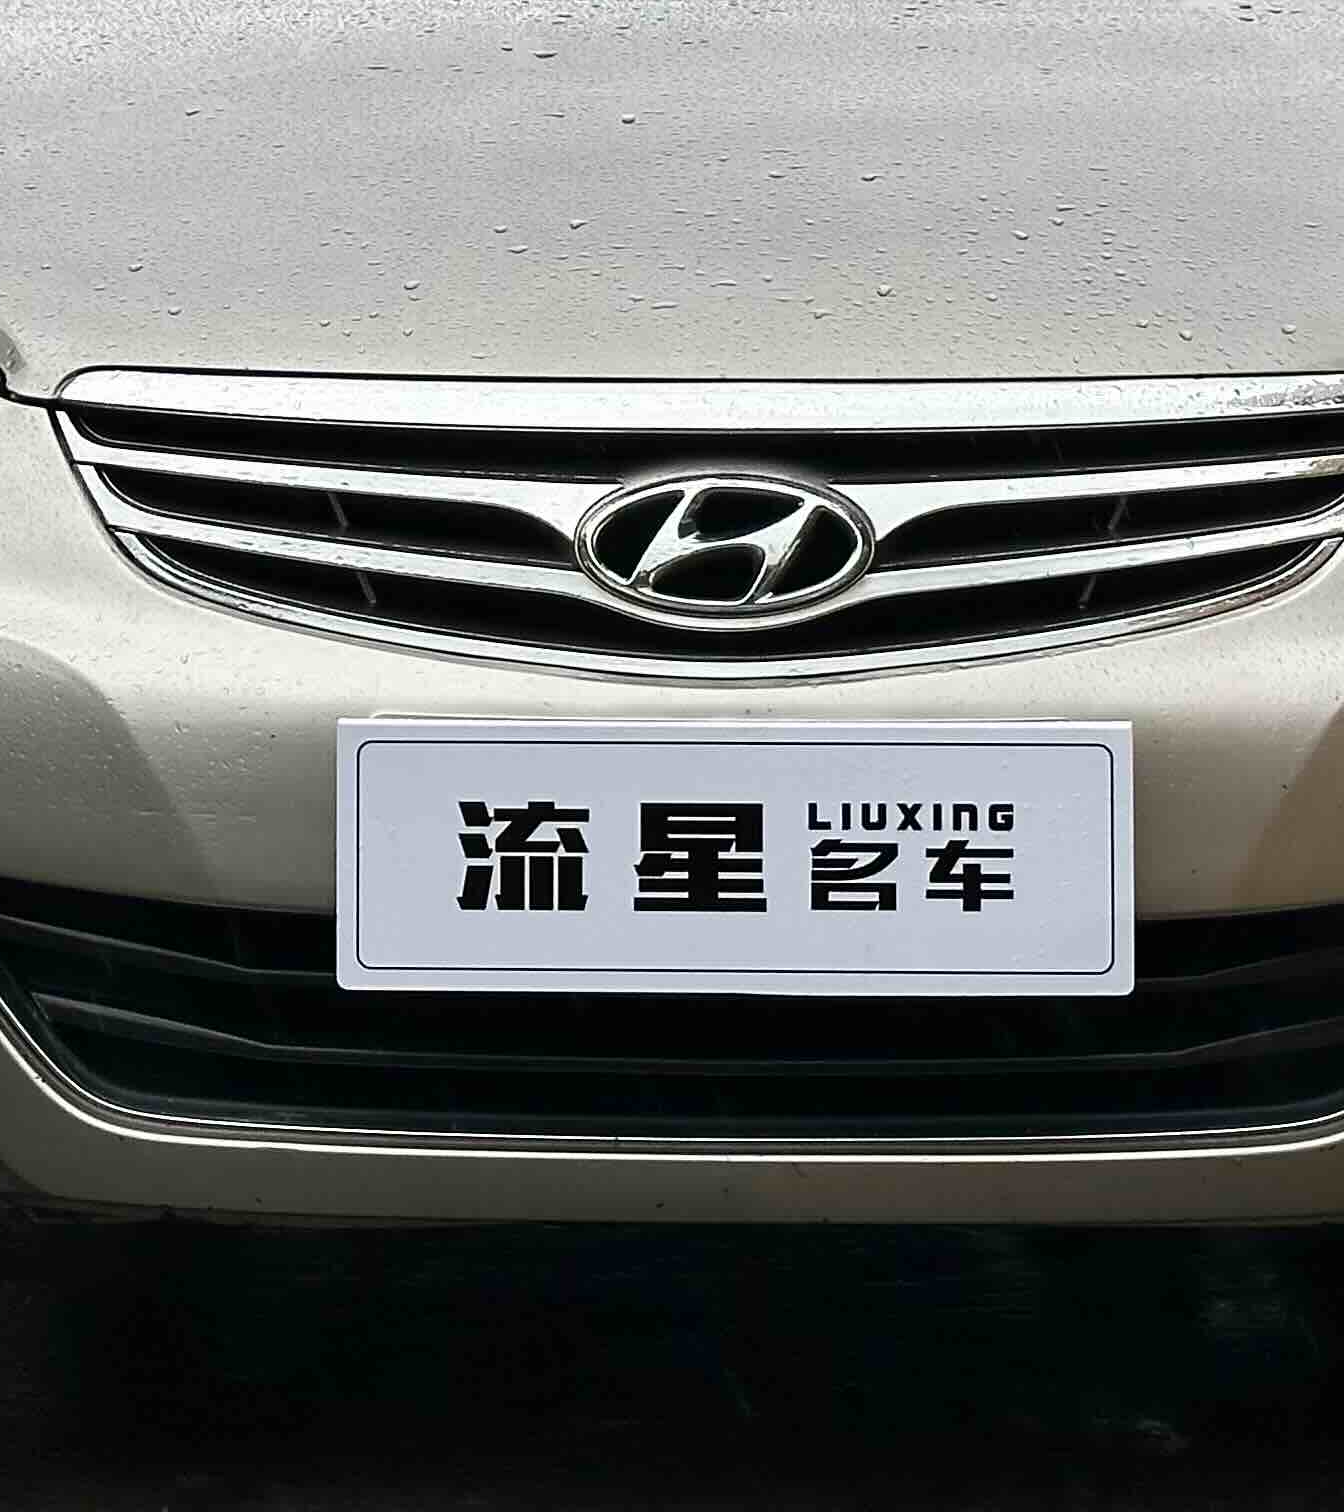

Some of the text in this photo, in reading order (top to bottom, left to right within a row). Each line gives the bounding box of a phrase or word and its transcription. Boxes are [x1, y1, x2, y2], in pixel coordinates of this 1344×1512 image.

[807, 802, 1015, 832] LIUXING
[457, 801, 768, 912] 流星
[809, 838, 1015, 912] 名车
